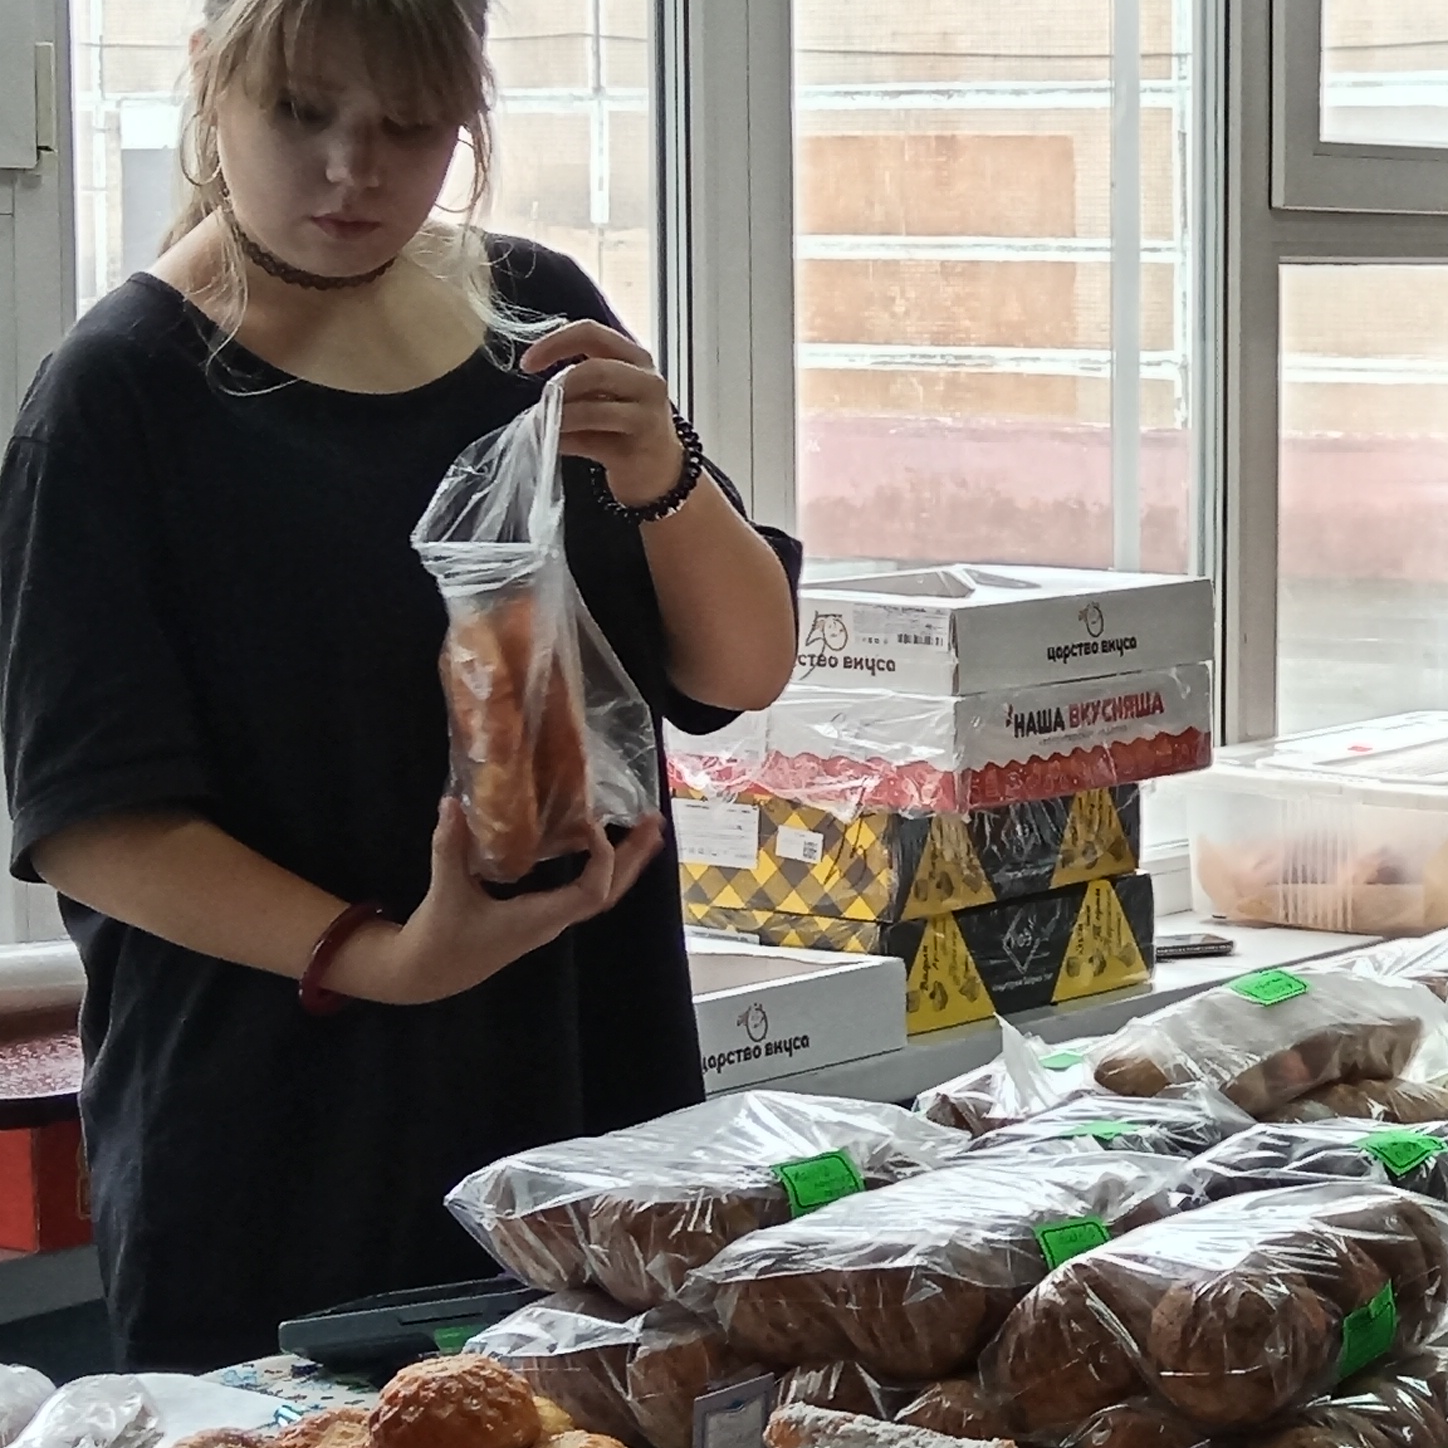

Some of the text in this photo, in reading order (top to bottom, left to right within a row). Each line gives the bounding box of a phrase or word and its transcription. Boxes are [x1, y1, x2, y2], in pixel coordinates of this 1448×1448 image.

[1047, 636, 1138, 663] царство вкуса
[794, 654, 896, 677] ство вкуса
[1012, 705, 1066, 740] НАША
[1068, 691, 1165, 730] ВКУСНЯША
[764, 1034, 811, 1062] вкуса
